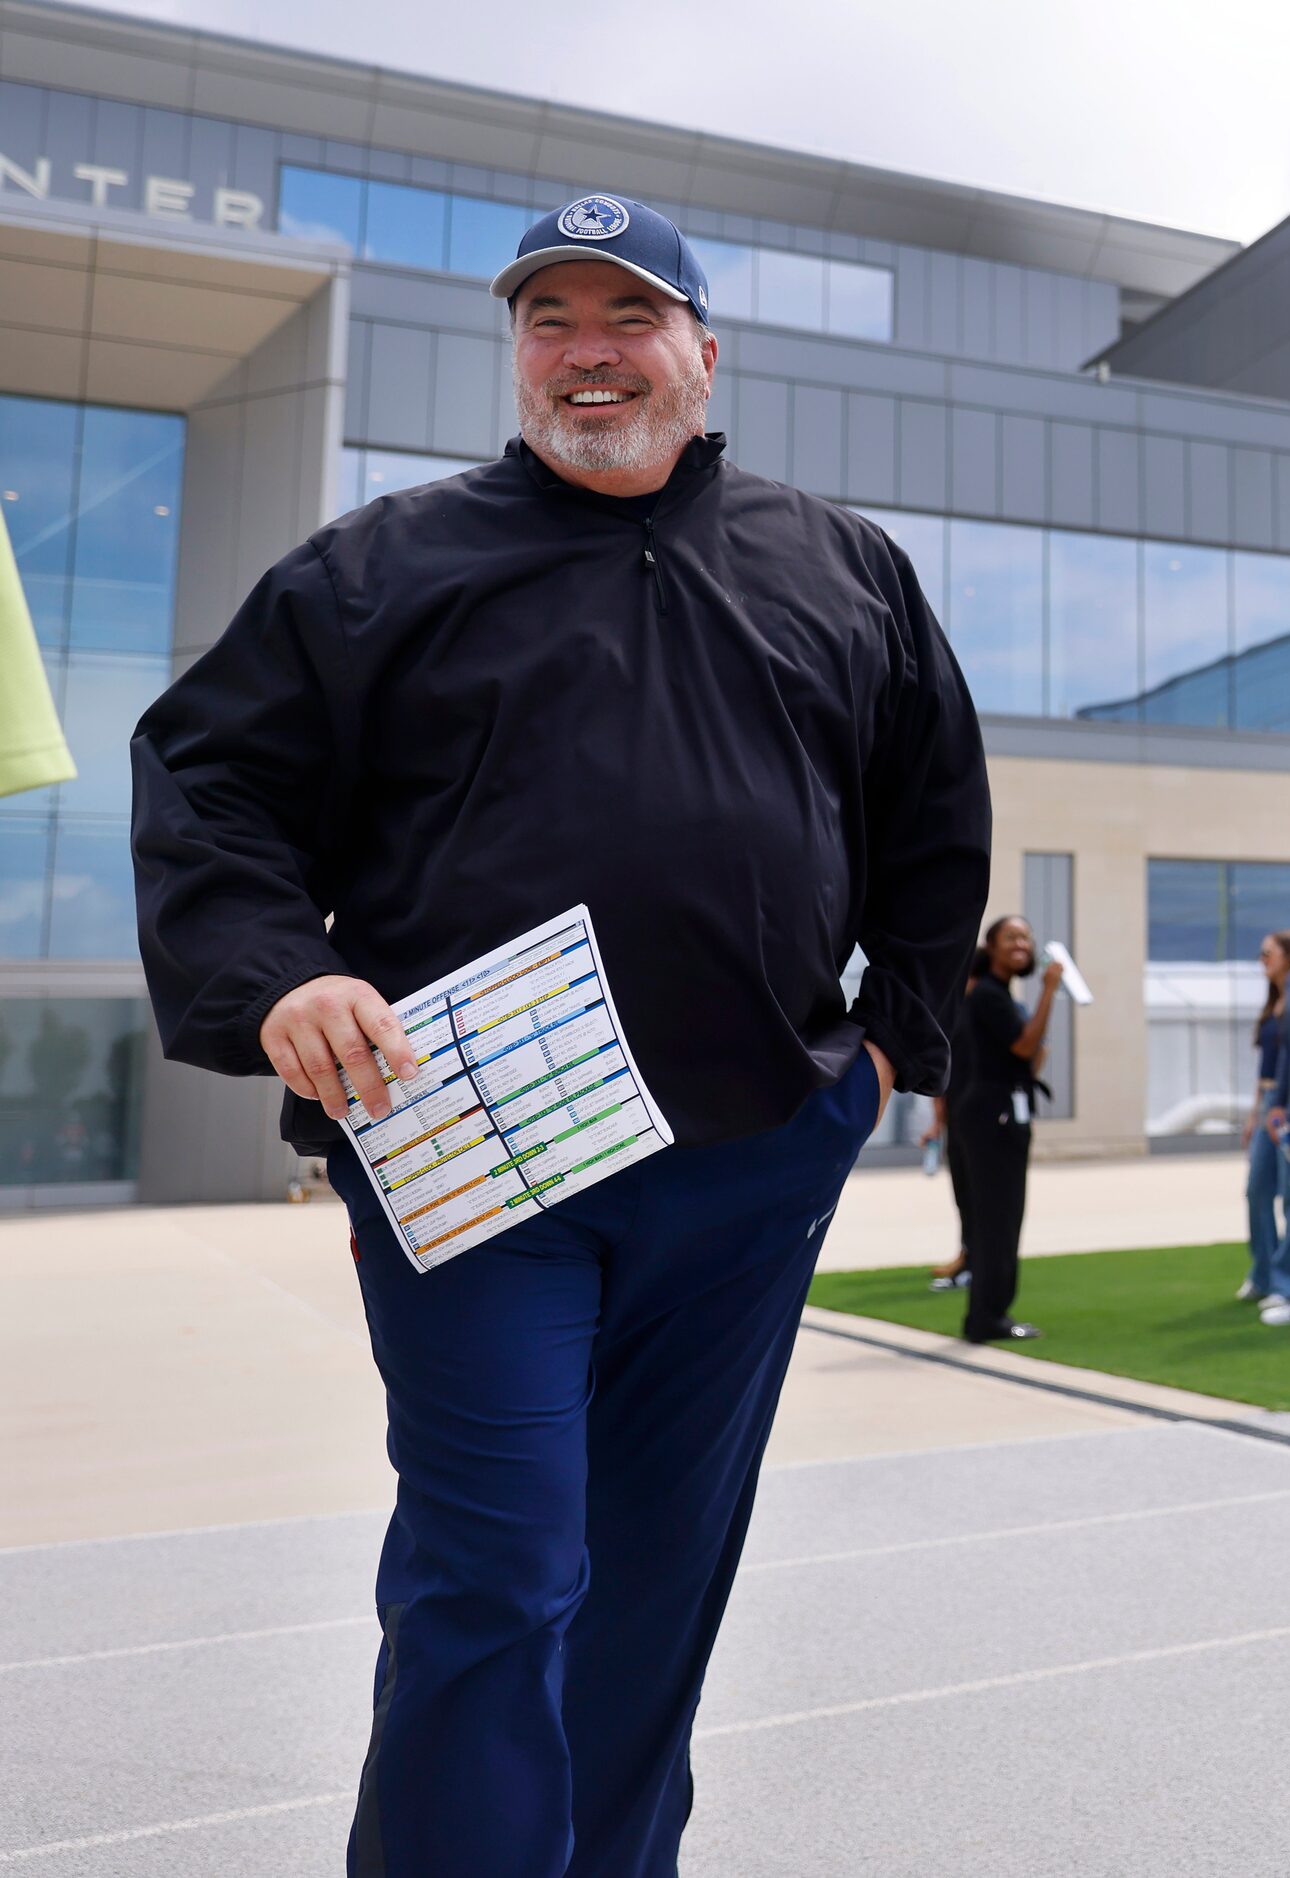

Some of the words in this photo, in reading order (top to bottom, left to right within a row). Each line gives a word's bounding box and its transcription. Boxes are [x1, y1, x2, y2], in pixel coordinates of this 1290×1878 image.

[576, 227, 608, 235] FOOTBALL
[407, 999, 432, 1016] MINUTE
[430, 984, 460, 1004] OFFENSE
[496, 1160, 514, 1173] MINUTE
[512, 1156, 522, 1164] 3RD
[521, 1148, 536, 1159] DOWN
[513, 1191, 531, 1204] MINUTE
[529, 1186, 539, 1195] 3RD
[538, 1179, 554, 1190] DOWN
